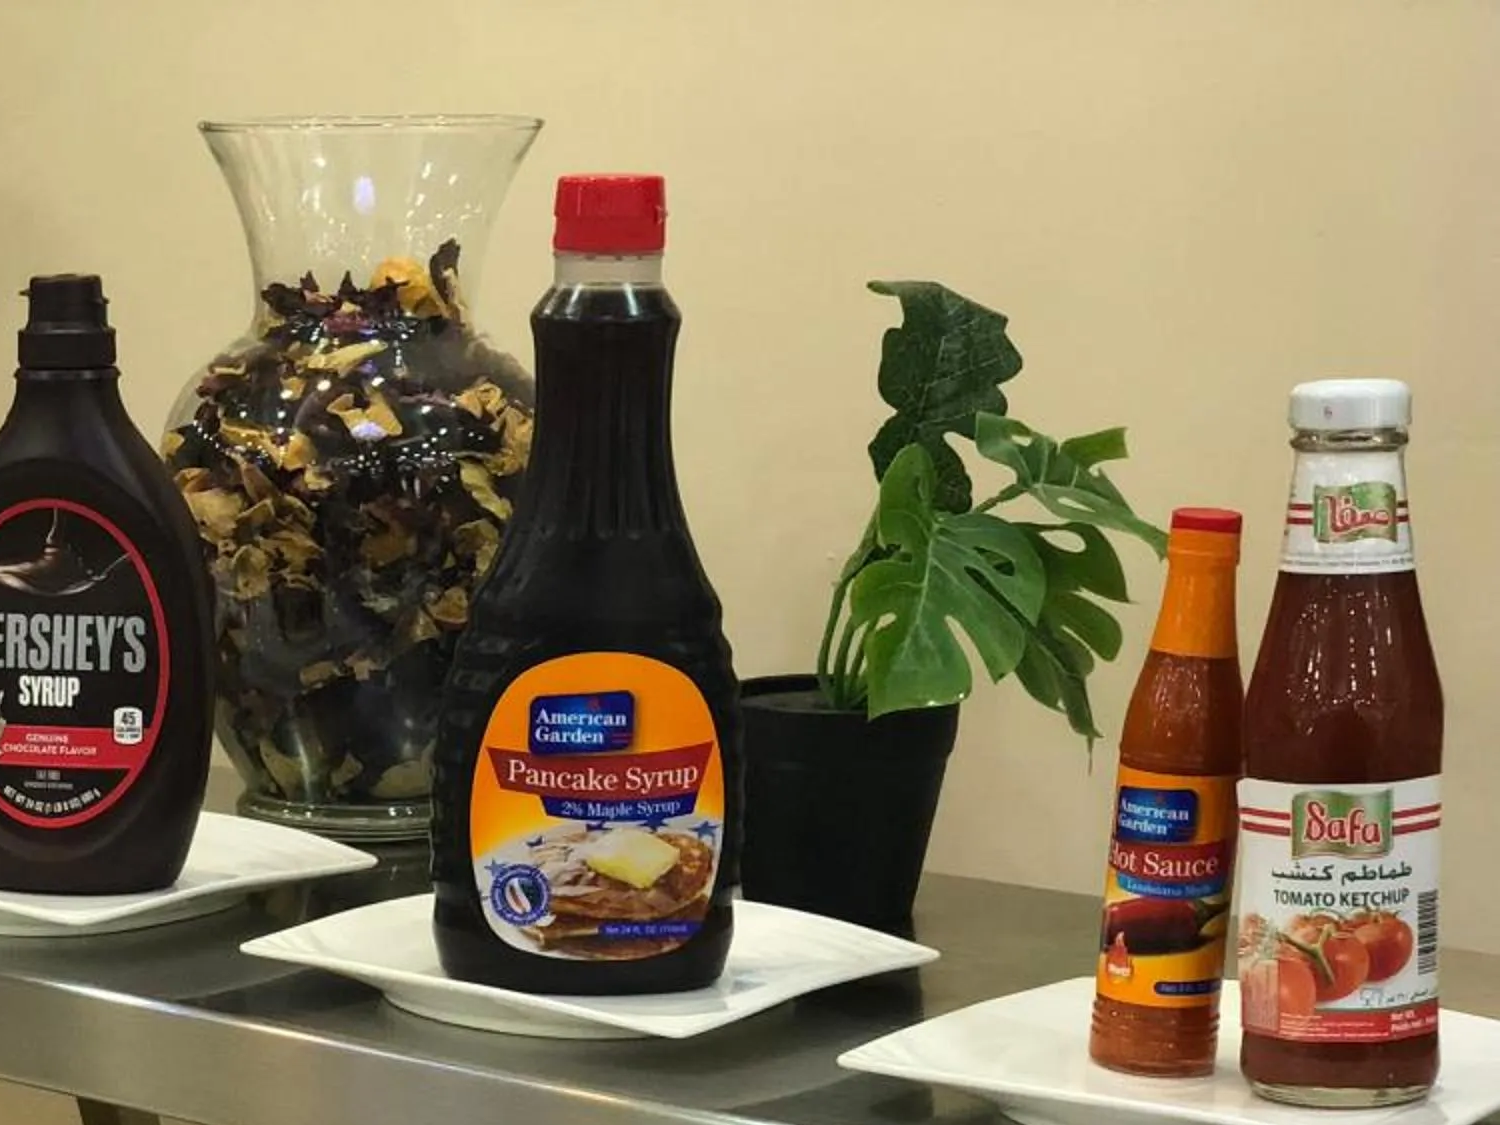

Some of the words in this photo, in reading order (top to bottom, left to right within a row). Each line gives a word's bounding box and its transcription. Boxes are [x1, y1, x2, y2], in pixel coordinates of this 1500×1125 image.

[18, 675, 81, 708] SYRUP
[121, 711, 137, 726] 45
[535, 708, 627, 727] American
[25, 732, 69, 744] GENUINE
[535, 726, 605, 745] Garden
[2, 742, 58, 755] CHOCOLATE
[60, 745, 97, 756] FLAVOR
[508, 759, 619, 792] Pancake
[625, 765, 699, 795] Syrup
[561, 801, 584, 817] 2%
[586, 803, 633, 819] Maple
[636, 800, 681, 816] Syrup
[1121, 797, 1189, 821] American
[1304, 799, 1382, 846] Safa
[1143, 851, 1219, 878] Sauce
[1340, 861, 1413, 886] طماطم
[1273, 889, 1335, 907] TOMATO
[1339, 887, 1410, 908] KETCHUP
